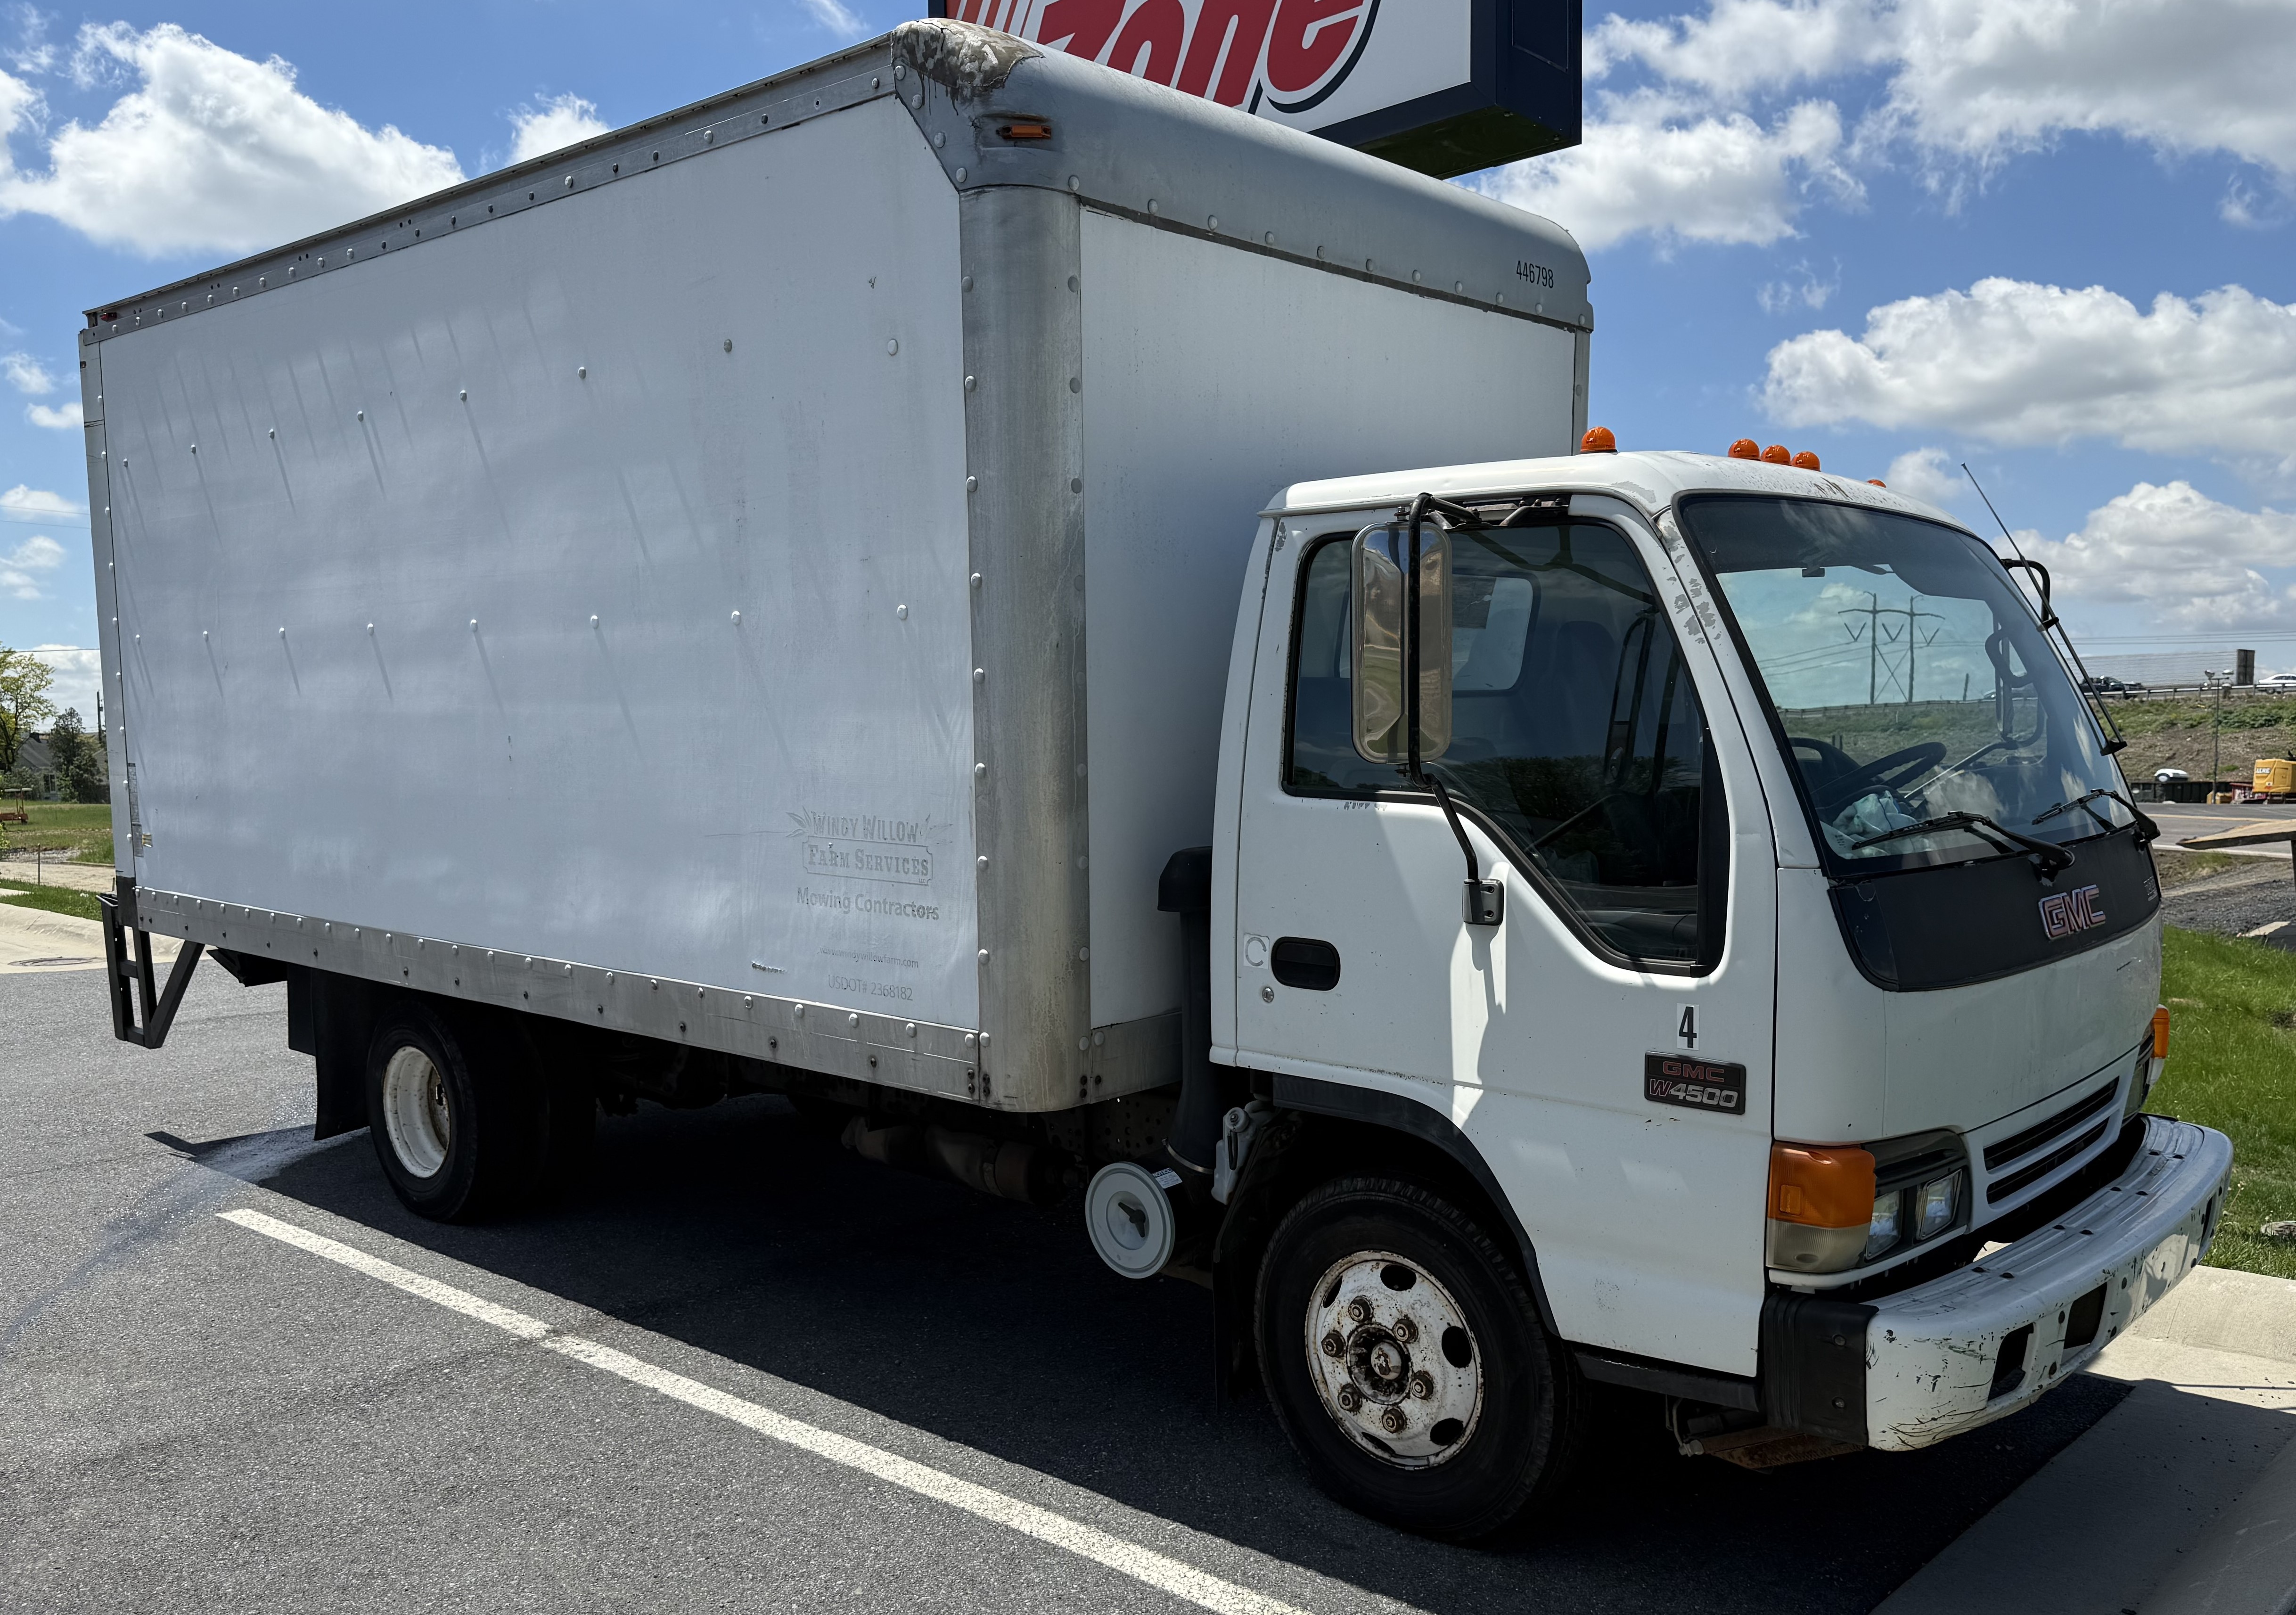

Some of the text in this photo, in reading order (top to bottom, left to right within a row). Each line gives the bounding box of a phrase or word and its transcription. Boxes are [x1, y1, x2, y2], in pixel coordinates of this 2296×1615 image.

[1516, 260, 1554, 288] 446798
[862, 814, 918, 843] WILLOW
[808, 844, 928, 876] FARM SERVICES
[797, 887, 939, 920] Mowing Contractors
[2038, 884, 2106, 940] GMC
[818, 947, 918, 968] www.windywillowfarm.com
[828, 974, 913, 1001] USDOT# 2368182
[1679, 1006, 1697, 1048] 4
[1663, 1061, 1724, 1082] GMC
[1650, 1079, 1738, 1107] W4500
